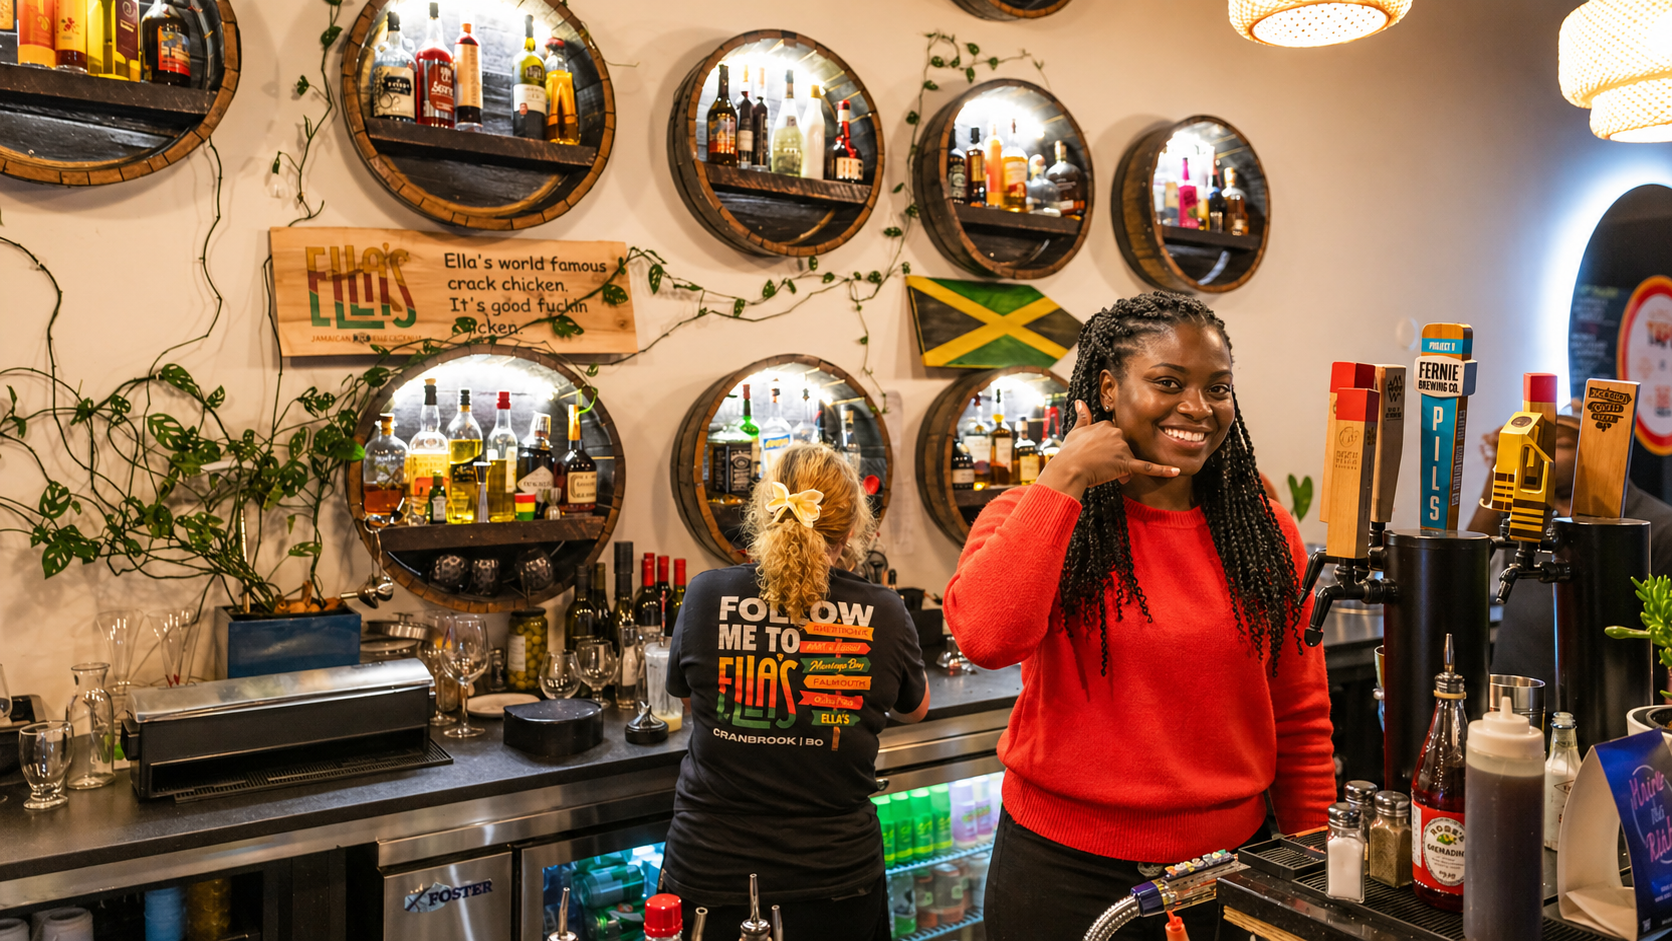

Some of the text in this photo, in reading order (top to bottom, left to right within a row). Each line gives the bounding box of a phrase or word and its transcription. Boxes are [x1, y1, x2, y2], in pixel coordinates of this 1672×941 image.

[444, 252, 607, 273] Ella's world famous
[305, 242, 417, 329] ELLA'S
[447, 275, 568, 292] crack chicken.
[449, 296, 588, 316] It's good fuckin
[311, 335, 351, 343] JAMAICAN
[1419, 361, 1459, 381] FERNIE
[1418, 379, 1459, 393] BREWING CO.
[1429, 405, 1444, 521] PILS
[719, 596, 874, 627] FOLOW
[718, 624, 757, 650] ME
[765, 626, 800, 653] TO
[716, 653, 799, 729] ELLA'S
[813, 678, 866, 687] FALMOUTH
[821, 713, 850, 725] ELLA'S
[713, 727, 796, 746] CRANBROOK
[428, 880, 493, 906] FOSTER
